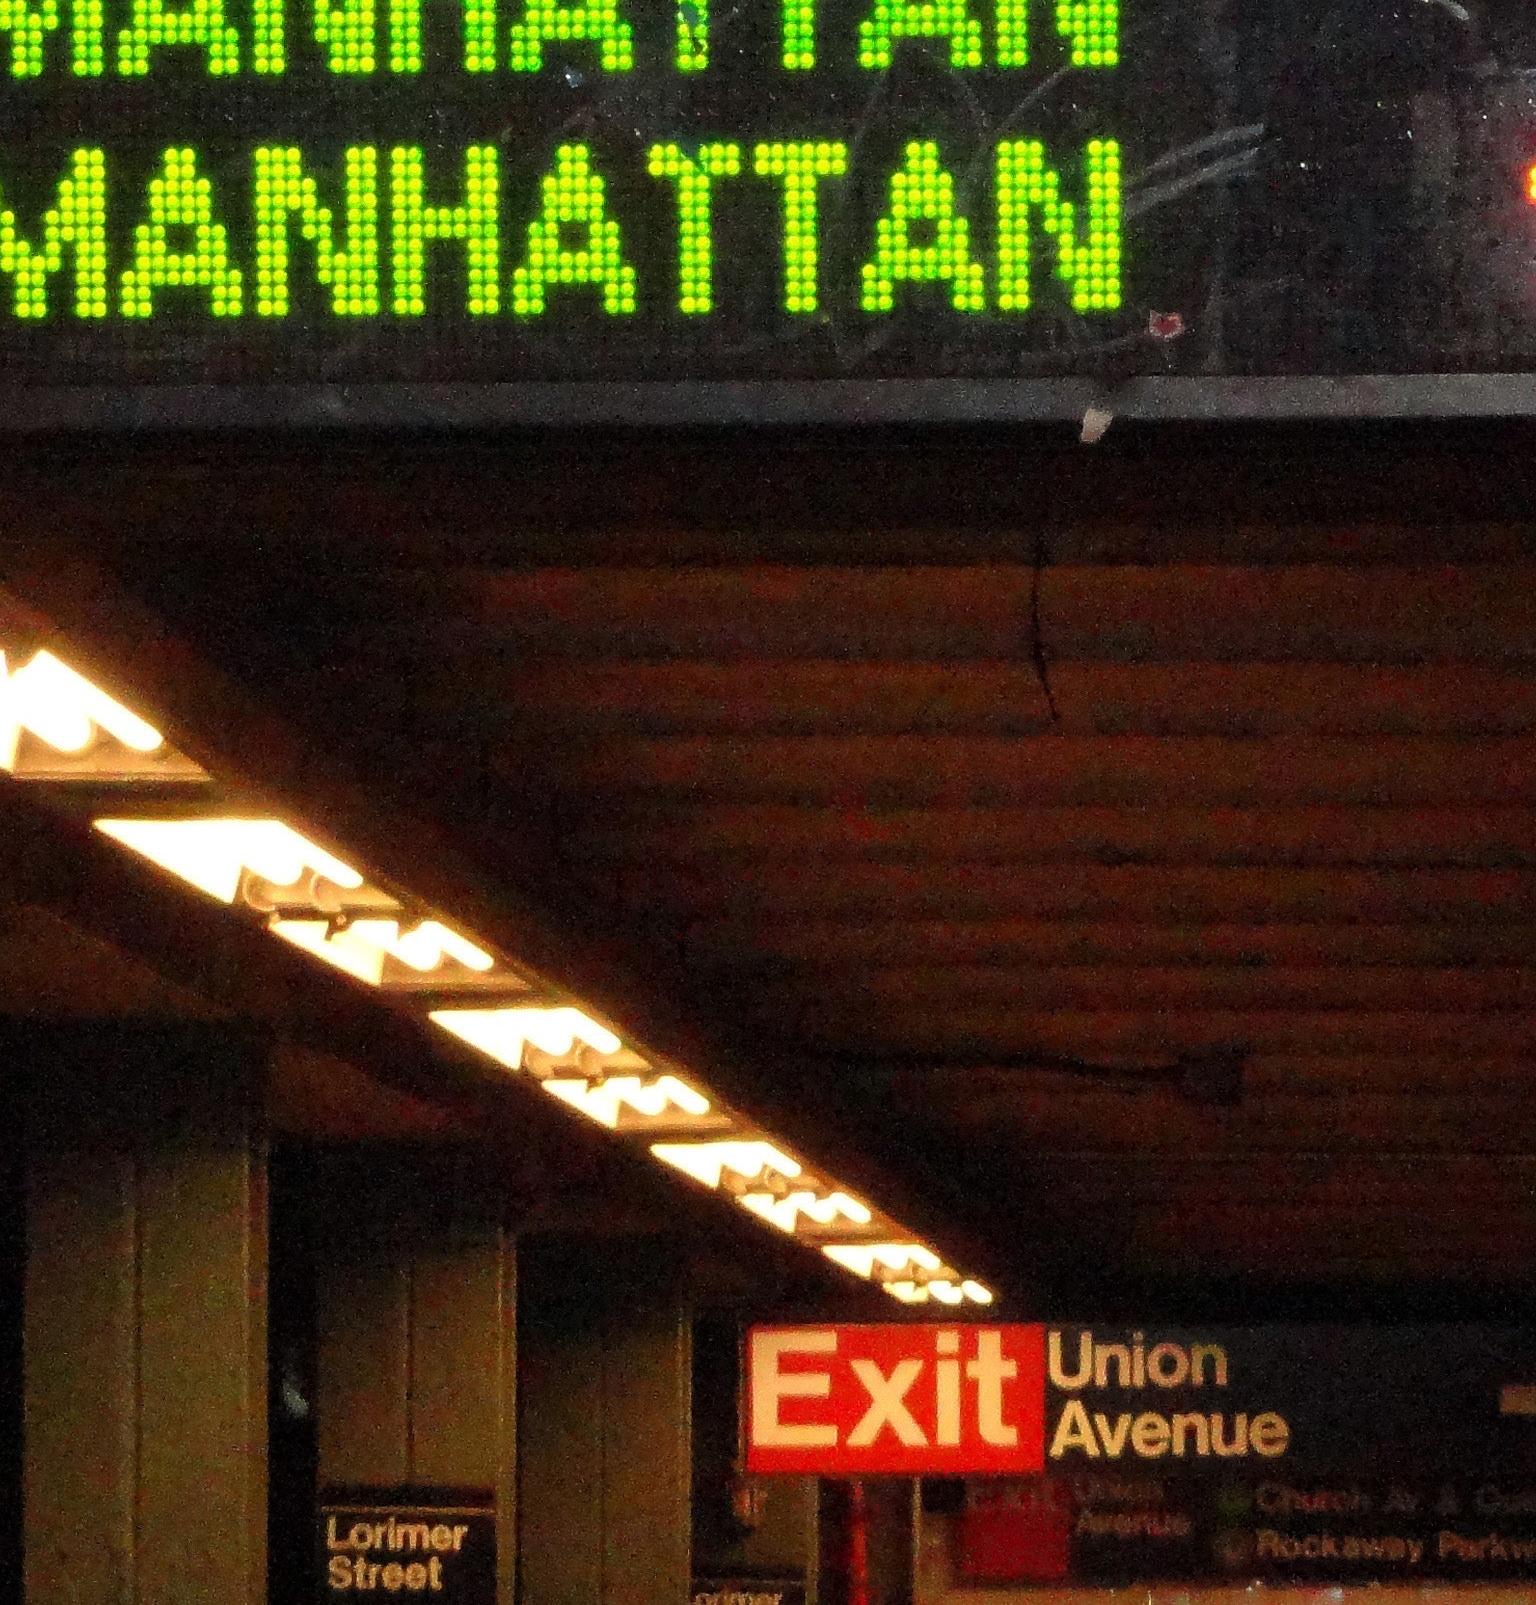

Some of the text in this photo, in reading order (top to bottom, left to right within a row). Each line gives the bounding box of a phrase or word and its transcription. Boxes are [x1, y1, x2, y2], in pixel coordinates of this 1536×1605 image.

[1048, 1331, 1228, 1389] Union
[750, 1331, 1018, 1448] Exit
[1049, 1398, 1290, 1458] Avenue
[325, 1515, 469, 1552] Lorimer
[1256, 1529, 1423, 1563] Rockaway
[326, 1555, 444, 1592] Street
